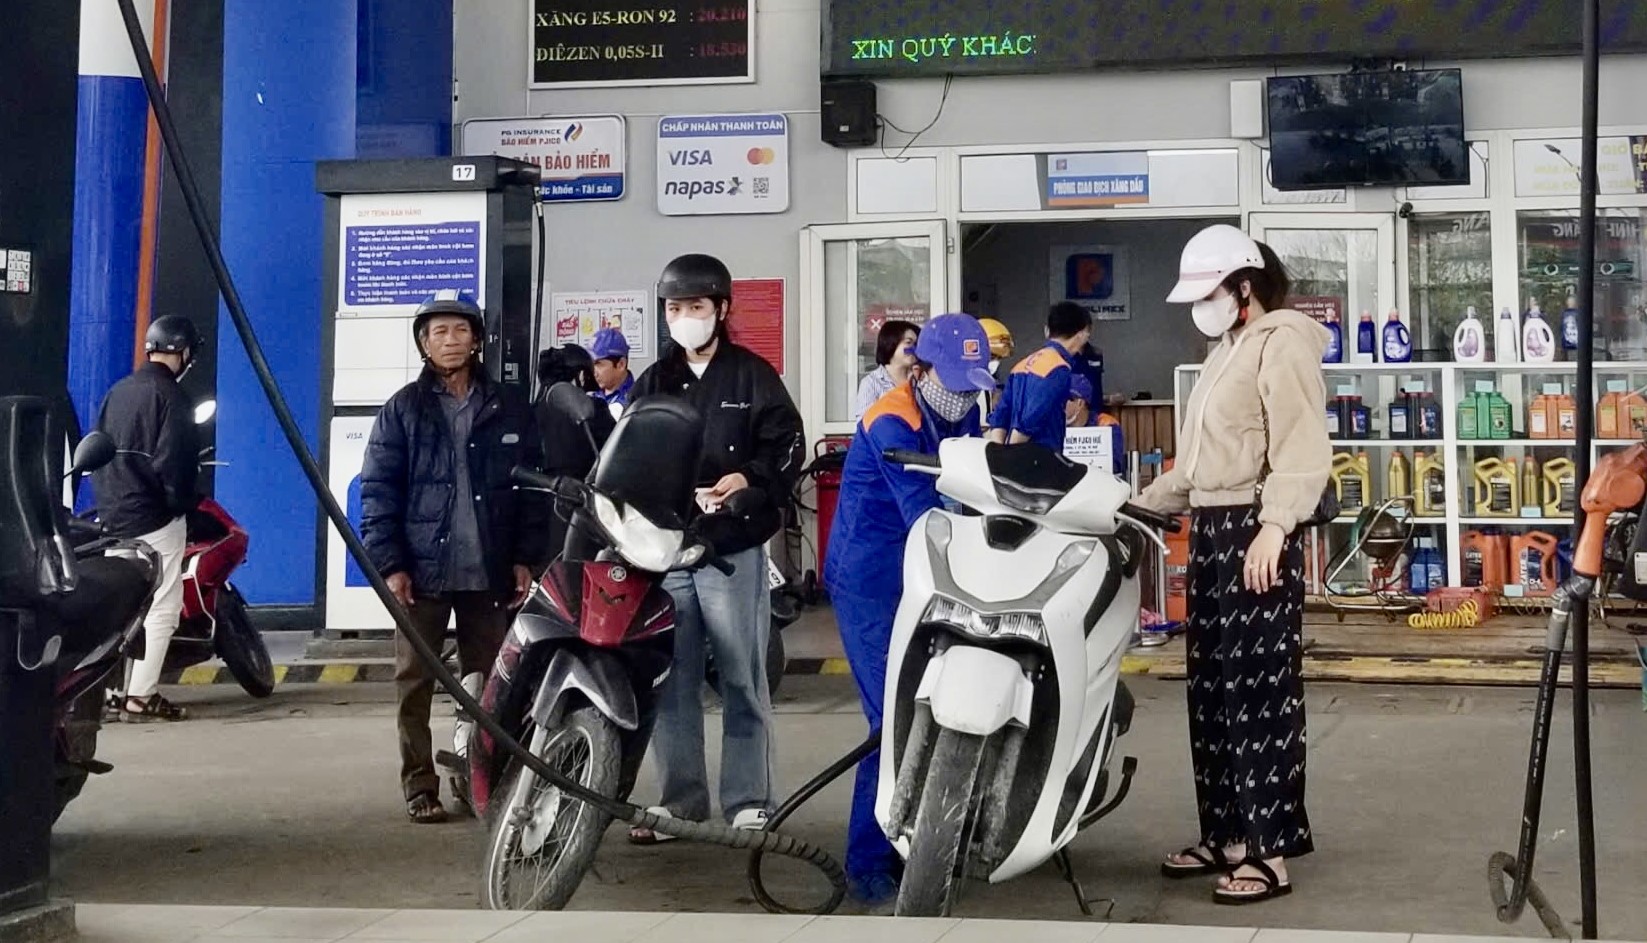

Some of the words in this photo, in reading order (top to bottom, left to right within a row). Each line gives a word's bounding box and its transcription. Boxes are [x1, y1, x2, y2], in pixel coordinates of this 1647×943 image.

[536, 11, 588, 27] XĂNG
[592, 9, 655, 26] E5-RON
[659, 9, 676, 24] 92
[604, 44, 664, 61] 0,05S-II
[851, 38, 893, 60] XIN
[901, 34, 956, 63] QUÝ
[962, 31, 1037, 57] KHÁC
[514, 128, 561, 136] INSURANCE
[662, 121, 689, 132] CHẤP
[721, 121, 754, 131] THANH
[756, 119, 783, 130] TOÁN
[539, 137, 561, 146] PJICO
[545, 151, 571, 170] BẢO
[576, 148, 611, 169] HIỂM
[668, 149, 713, 166] VISA
[456, 167, 472, 178] 17
[665, 180, 725, 199] napas
[345, 432, 363, 440] VISA
